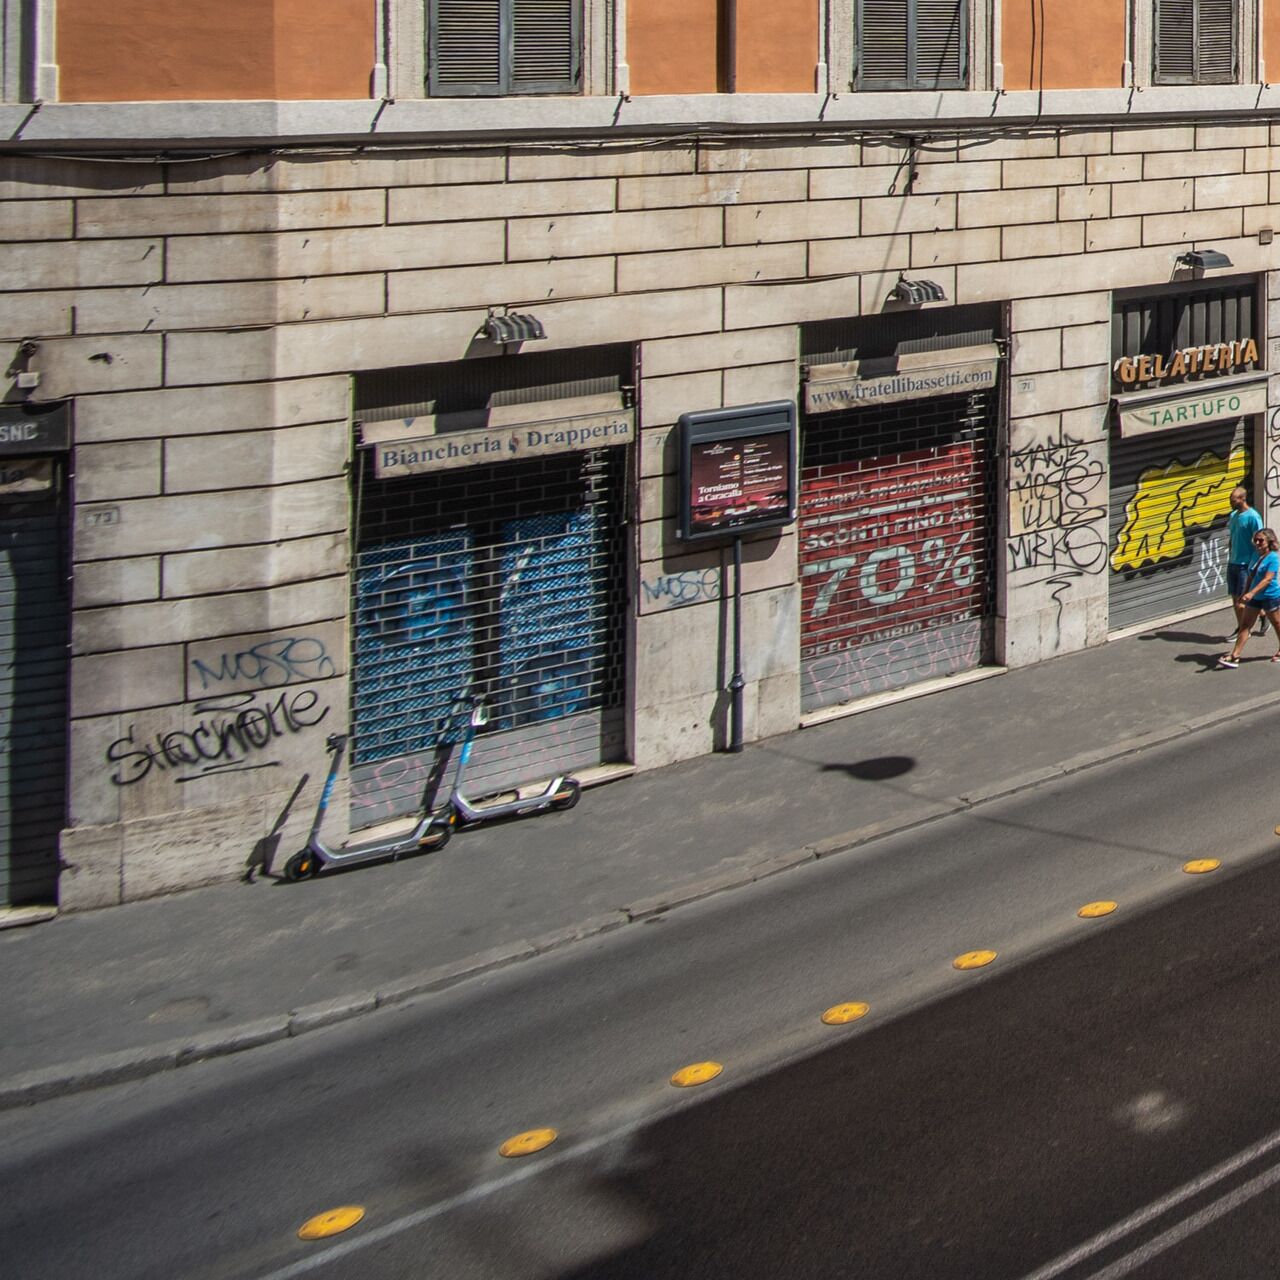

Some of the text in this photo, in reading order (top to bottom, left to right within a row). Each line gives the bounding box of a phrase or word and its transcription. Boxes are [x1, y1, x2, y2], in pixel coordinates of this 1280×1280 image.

[1114, 338, 1258, 383] GELATERIA
[811, 369, 992, 405] www.fratellibassetti.com
[1150, 396, 1241, 427] TARTUFO
[383, 420, 629, 468] Biancheria Drapperia
[698, 482, 739, 494] Torniamo
[704, 489, 742, 501] Caracalla
[804, 521, 889, 550] SCONTI
[895, 511, 944, 531] FINO
[802, 531, 976, 618] 70%
